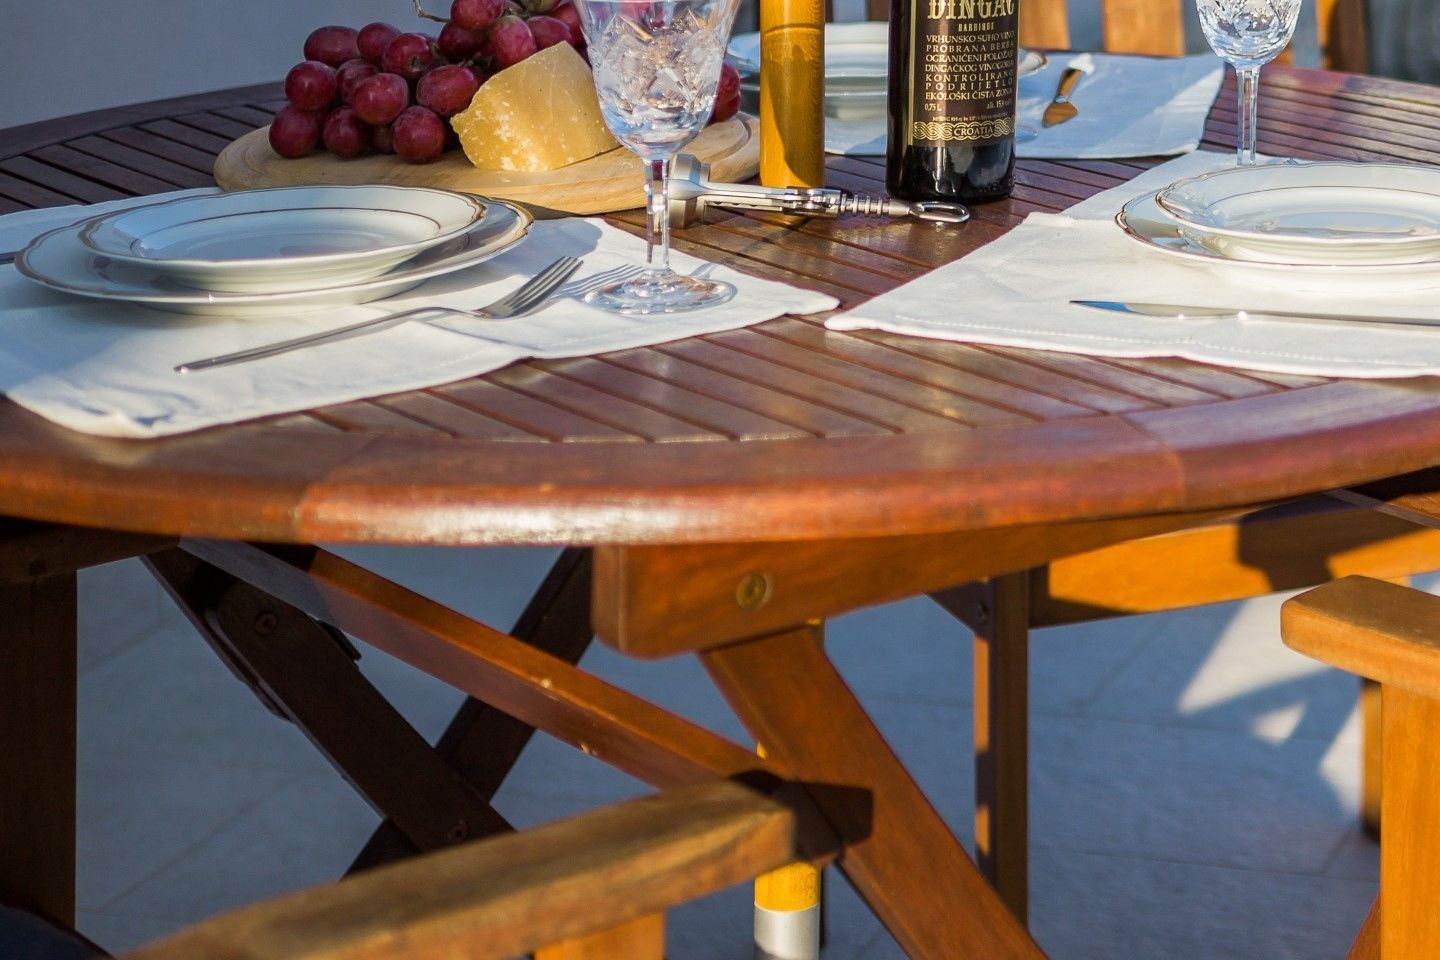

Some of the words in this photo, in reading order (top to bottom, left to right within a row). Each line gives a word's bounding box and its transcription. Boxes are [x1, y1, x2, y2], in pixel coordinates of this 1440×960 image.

[958, 22, 994, 32] BARRIQUE
[926, 35, 976, 44] VRHUNSKO
[977, 33, 1000, 42] SUHO
[926, 44, 986, 53] PROBRANA
[925, 53, 982, 63] OGRANIČENI
[925, 63, 977, 72] DINGAČKOG
[925, 69, 1013, 82] KONTROLIRANO
[925, 78, 1013, 91] PODRIJETLO
[925, 91, 970, 100] EKOLOŠKI
[971, 90, 994, 99] ČISTA
[936, 103, 941, 111] L
[953, 126, 993, 136] CROATIA
